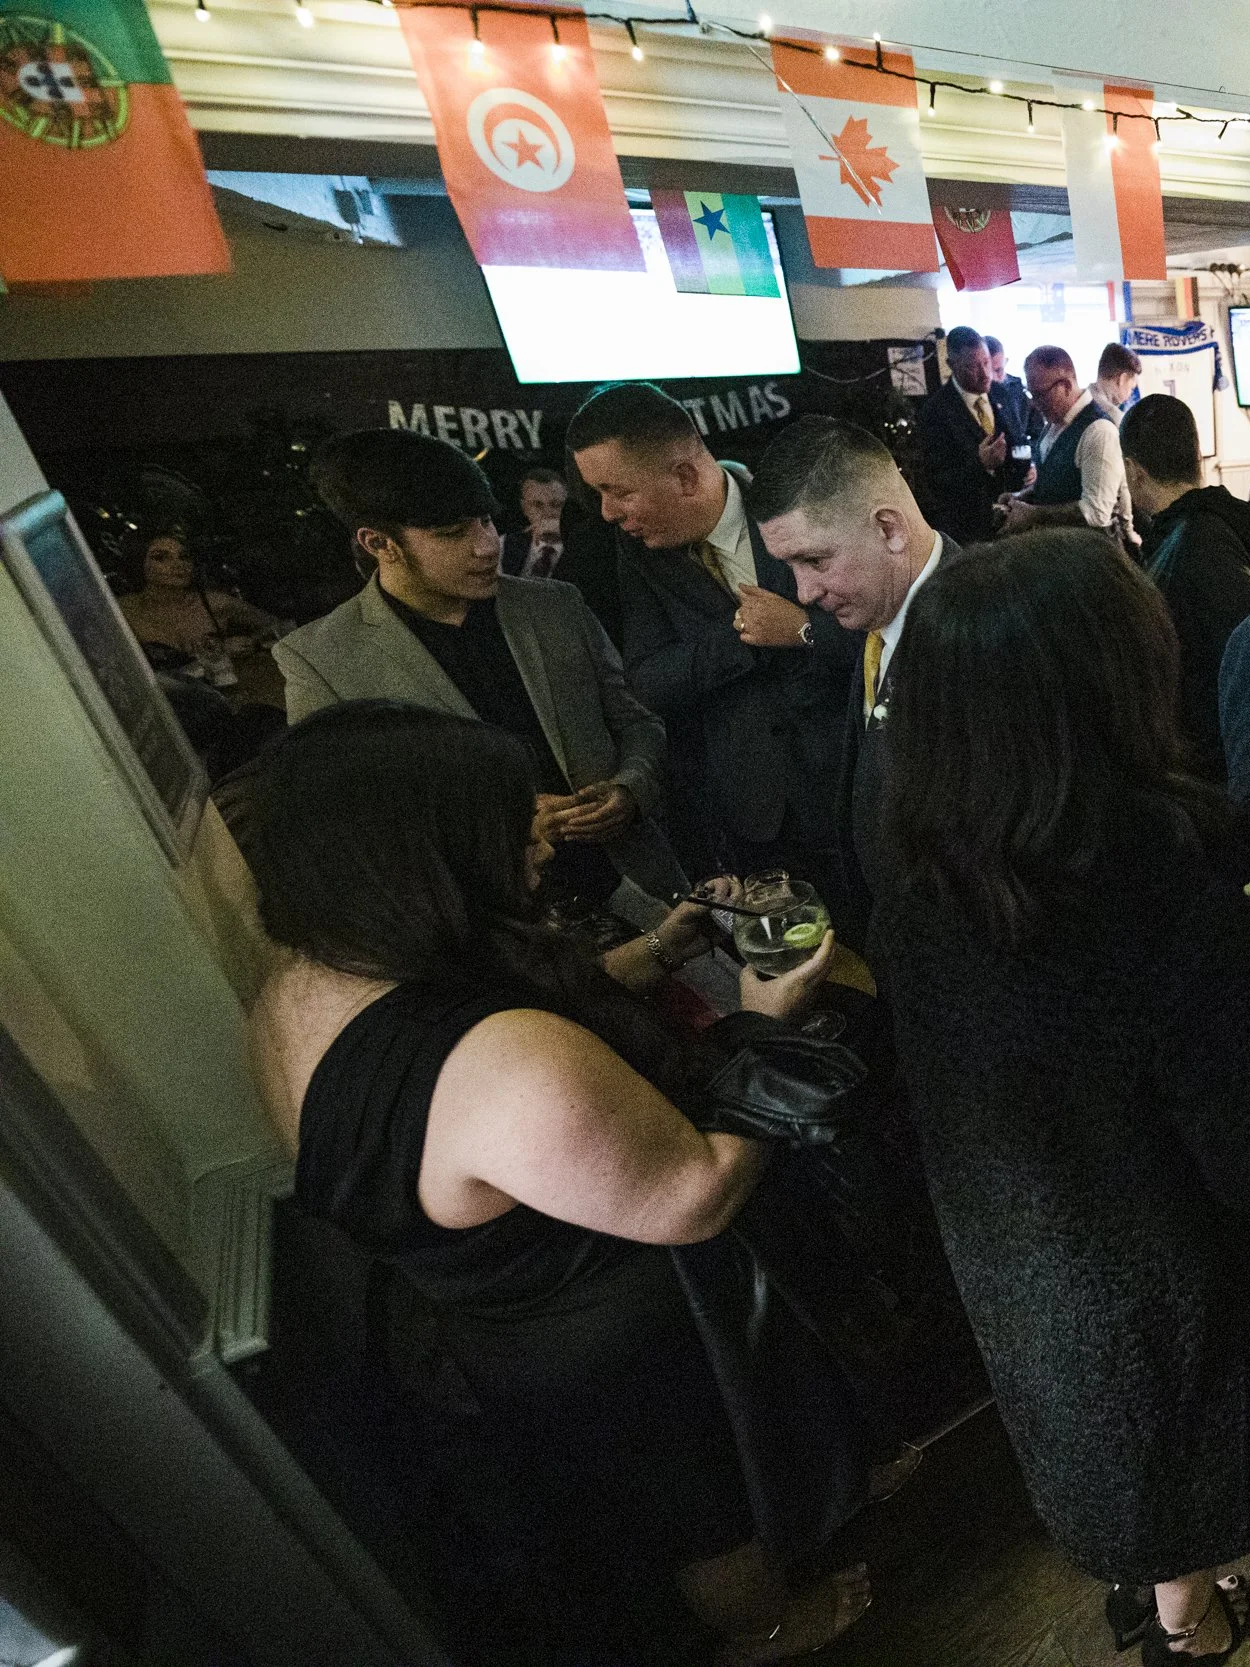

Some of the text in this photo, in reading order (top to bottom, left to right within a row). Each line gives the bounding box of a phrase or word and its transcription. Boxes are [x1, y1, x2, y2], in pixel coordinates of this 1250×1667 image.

[1132, 331, 1160, 347] MERE
[1163, 329, 1207, 347] ROVERS
[388, 381, 791, 449] MERRY TMAS
